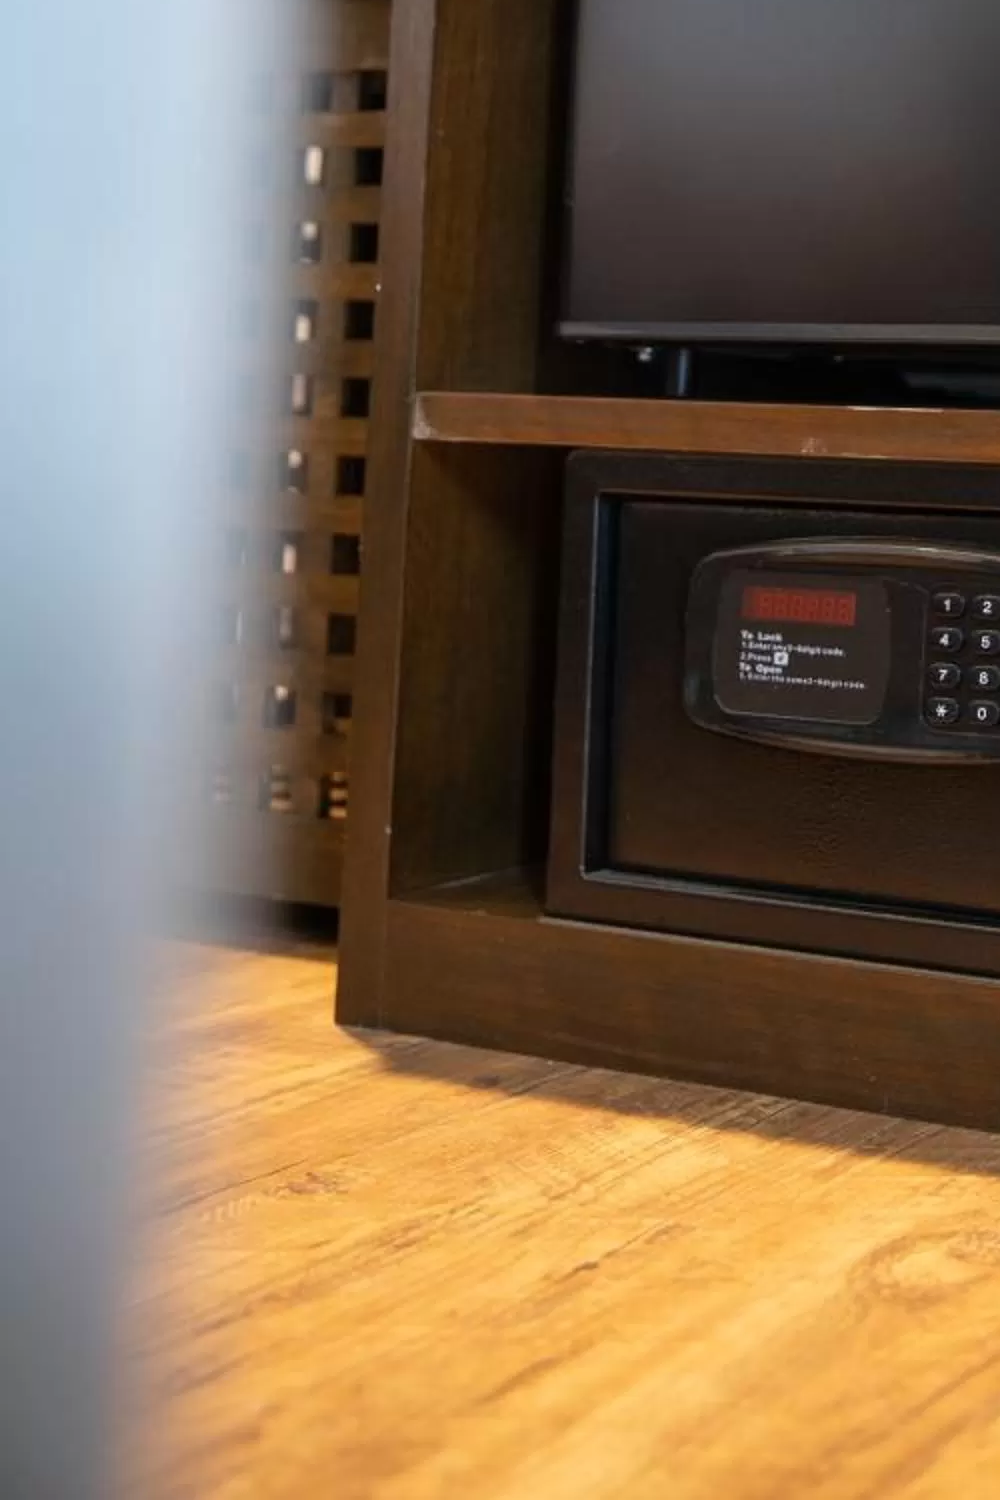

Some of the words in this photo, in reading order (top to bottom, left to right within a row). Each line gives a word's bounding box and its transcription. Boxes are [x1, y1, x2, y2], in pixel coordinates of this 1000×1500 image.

[943, 598, 951, 612] 1
[982, 601, 992, 614] 2
[939, 633, 949, 646] 4
[981, 635, 990, 649] 5
[938, 669, 948, 681] 7
[979, 671, 989, 685] 8
[977, 707, 987, 720] 0
